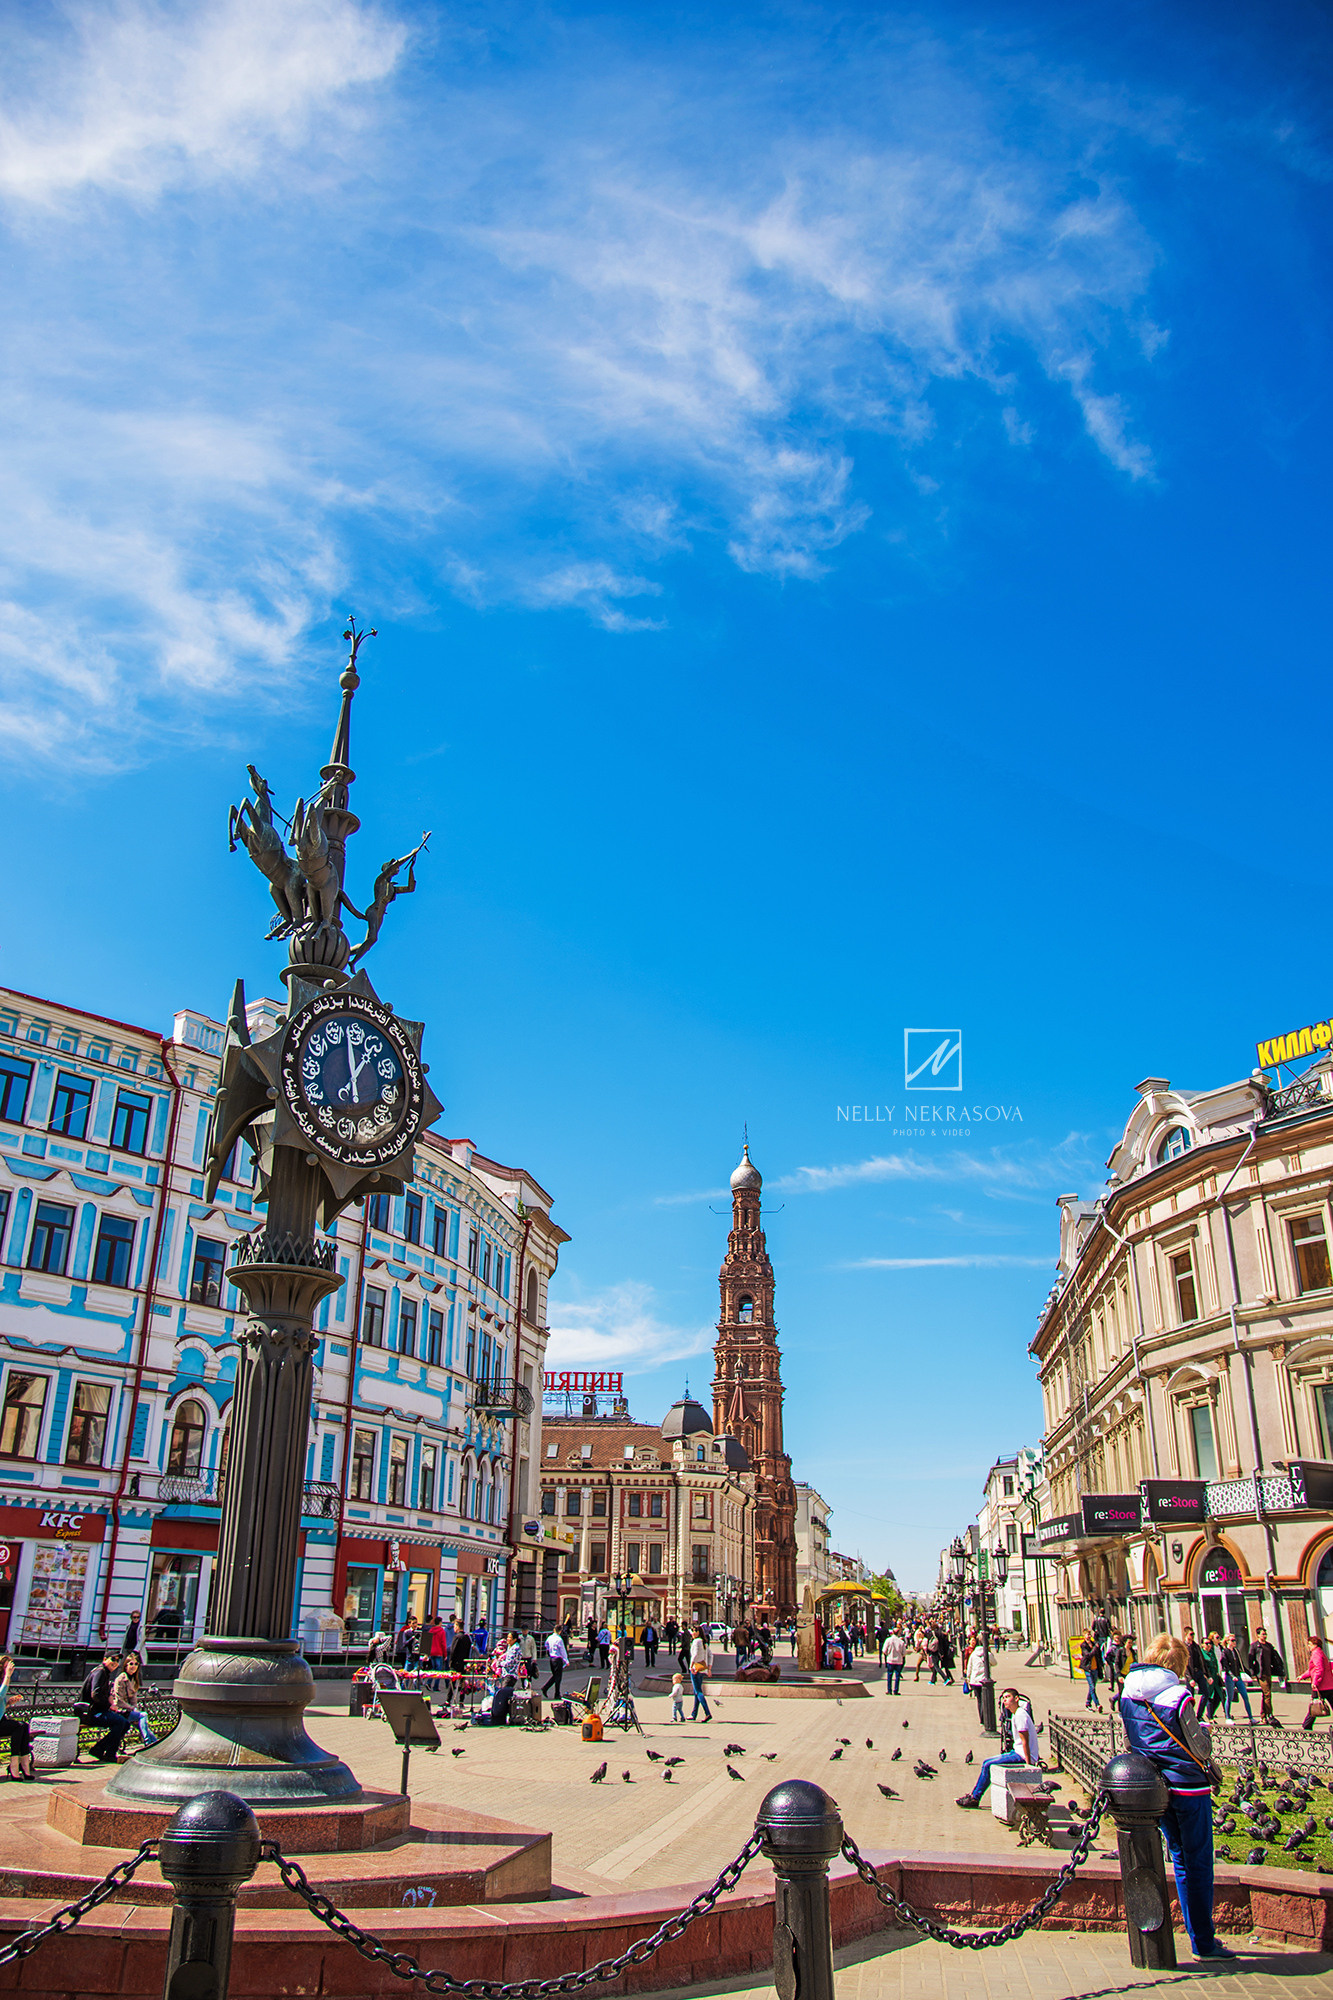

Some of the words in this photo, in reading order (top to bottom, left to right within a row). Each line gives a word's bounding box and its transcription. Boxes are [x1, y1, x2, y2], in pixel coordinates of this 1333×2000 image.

[1257, 1018, 1333, 1068] КИЛЛФ
[1290, 1466, 1307, 1504] ГУМ
[1158, 1496, 1199, 1508] re:Store
[40, 1512, 84, 1529] KFC
[1094, 1509, 1137, 1520] re:Store
[56, 1529, 82, 1539] Express
[487, 1557, 499, 1575] KFC
[1205, 1565, 1243, 1582] re:Store
